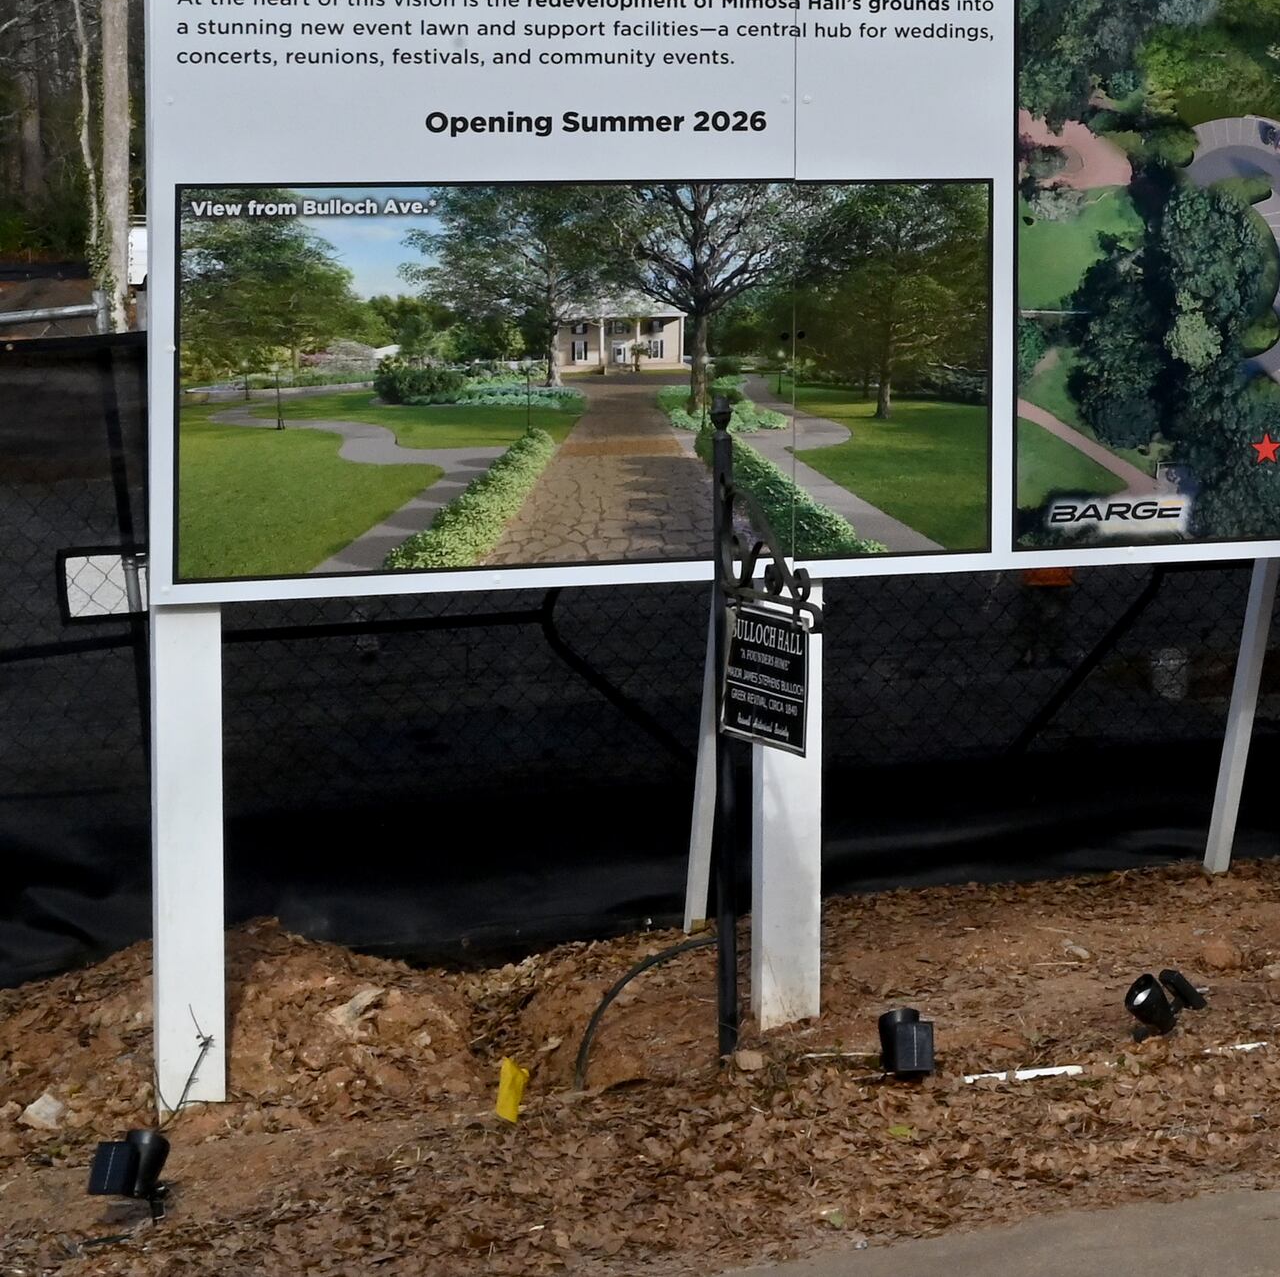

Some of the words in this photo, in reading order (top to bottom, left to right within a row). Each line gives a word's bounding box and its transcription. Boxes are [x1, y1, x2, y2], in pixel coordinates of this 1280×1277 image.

[176, 22, 189, 35] a
[196, 18, 293, 39] stunning
[300, 22, 345, 36] new
[352, 20, 413, 36] event
[420, 19, 469, 36] lawn
[476, 19, 516, 37] and
[523, 21, 606, 40] support
[736, 21, 807, 38] central
[814, 21, 852, 39] hub
[858, 22, 888, 39] for
[894, 22, 994, 42] weddings,
[176, 48, 278, 67] concerts,
[285, 47, 385, 68] reunions,
[391, 47, 485, 68] festivals,
[492, 48, 532, 65] and
[538, 48, 656, 68] community
[662, 49, 735, 65] events.
[424, 110, 553, 138] Opening
[561, 111, 685, 133] Summer
[692, 110, 767, 133] 2026
[191, 200, 242, 216] View
[248, 200, 297, 215] from
[303, 199, 378, 215] Bulloch
[1050, 500, 1184, 523] BARGE
[777, 628, 803, 656] HALL
